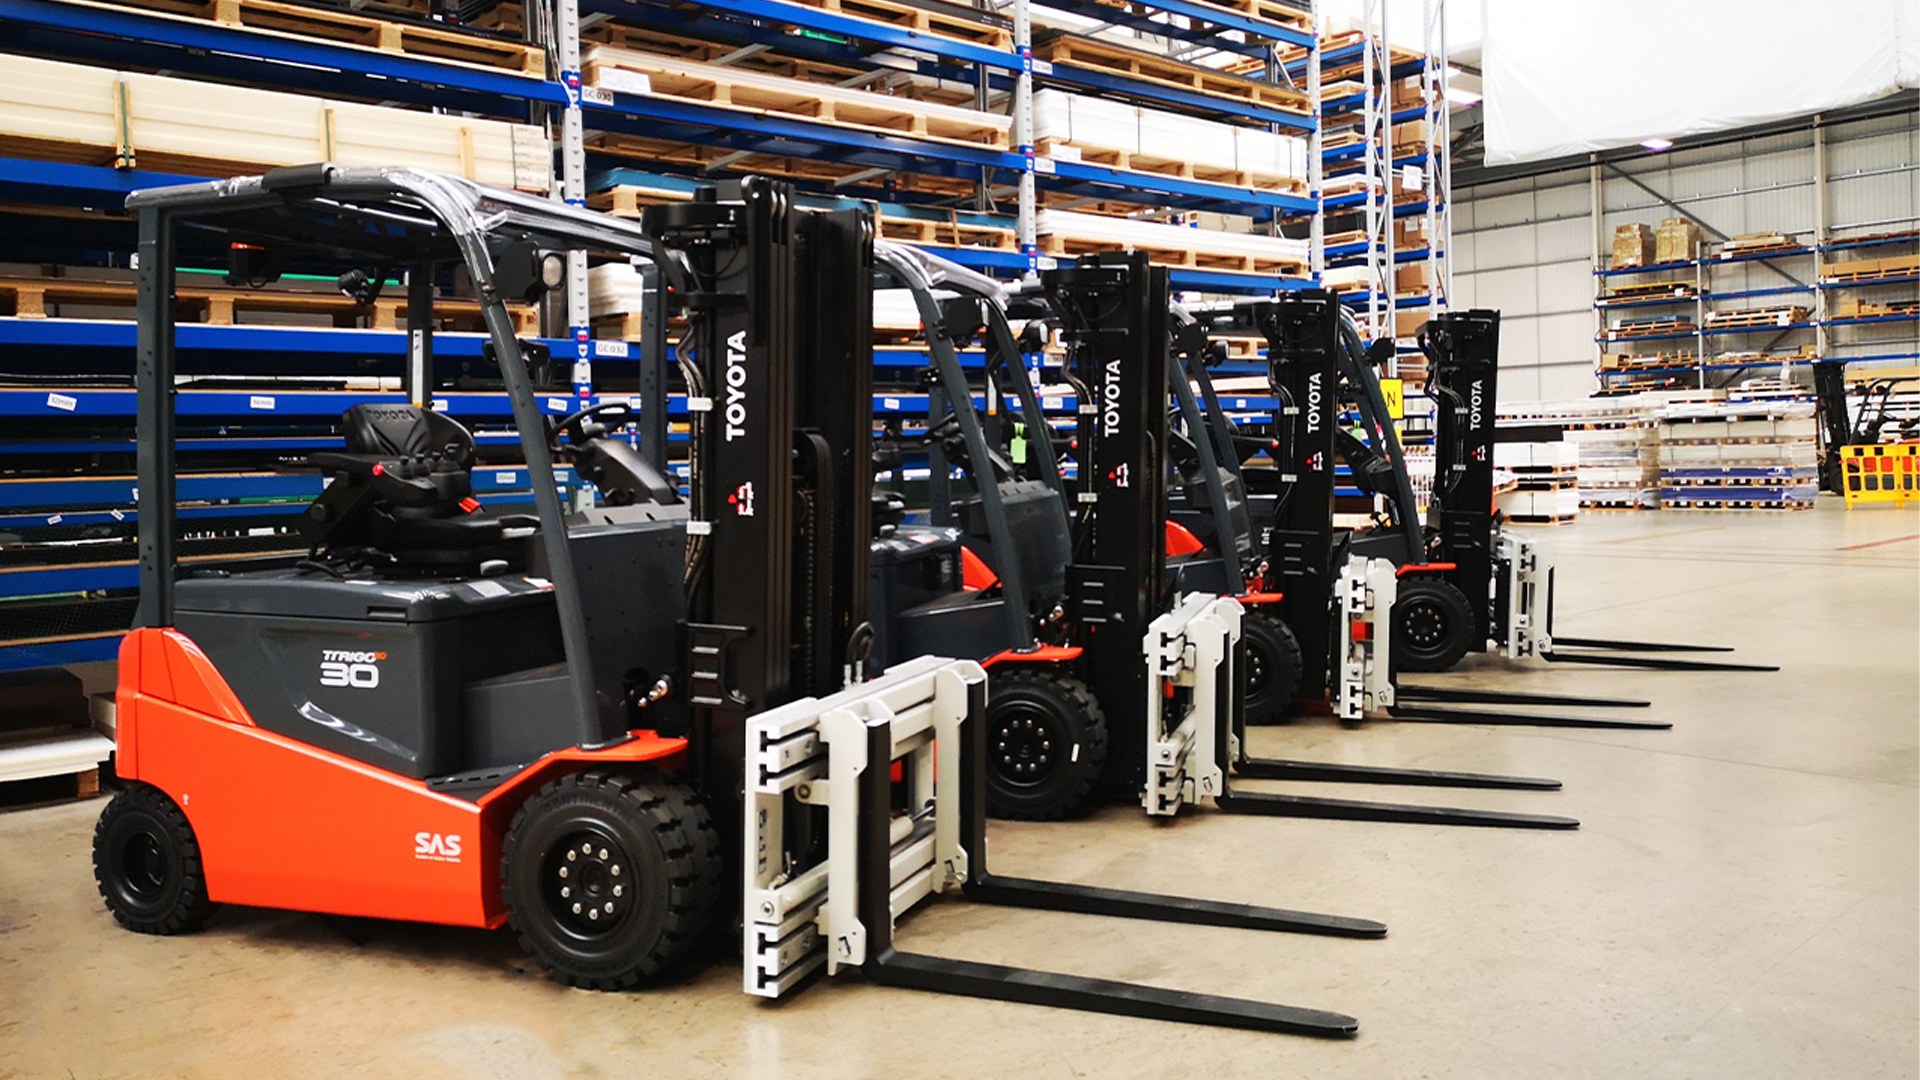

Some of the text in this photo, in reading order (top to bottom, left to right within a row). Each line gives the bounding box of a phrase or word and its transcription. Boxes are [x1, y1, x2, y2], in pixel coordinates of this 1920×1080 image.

[598, 344, 609, 353] GC
[725, 330, 747, 443] TOYOTA
[1104, 359, 1121, 438] TOYOTA
[1387, 391, 1396, 407] N
[366, 409, 416, 421] TOYOTA
[1307, 372, 1322, 434] TOYOTA
[1470, 379, 1483, 431] TOYOTA
[319, 662, 379, 689] 30
[415, 831, 461, 857] SAS
